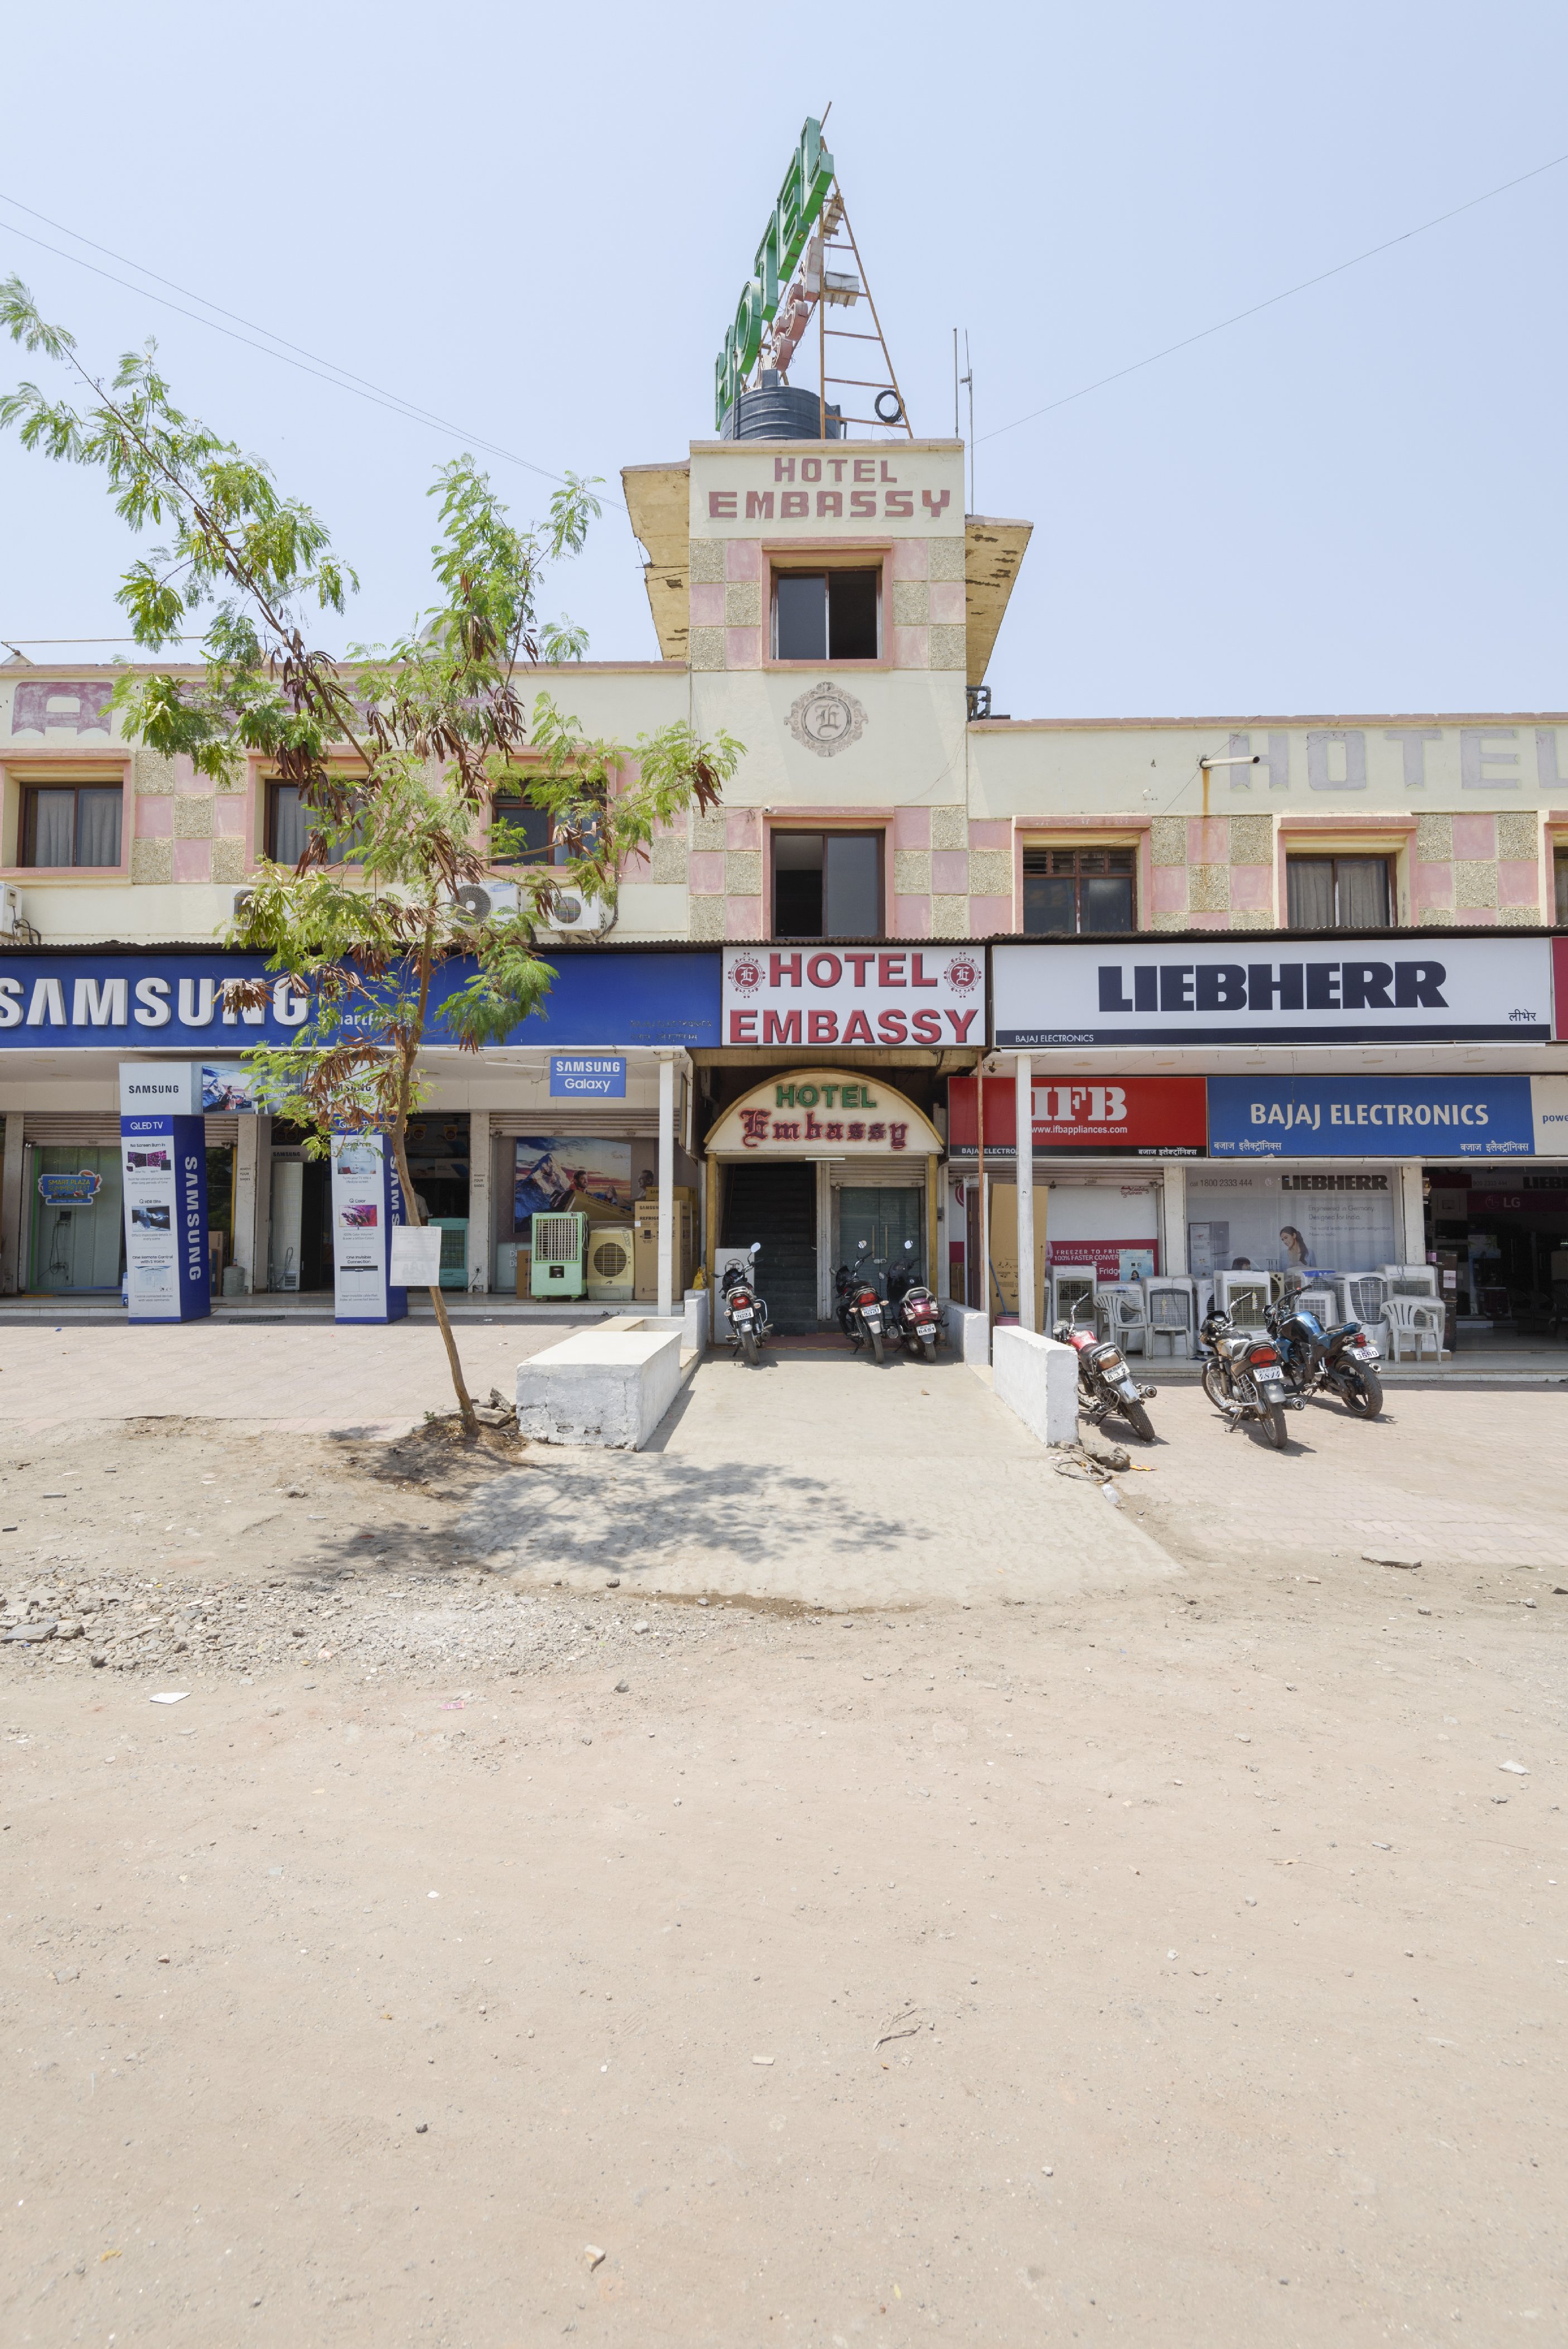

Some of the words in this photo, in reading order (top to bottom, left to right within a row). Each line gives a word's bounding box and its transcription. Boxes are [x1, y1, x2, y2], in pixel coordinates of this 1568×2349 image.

[715, 117, 834, 432] HOTEL
[774, 457, 898, 483] HOTEL
[708, 489, 951, 519] EMBASSY
[1229, 727, 1568, 790] HOTEL
[769, 952, 938, 988] HOTEL
[1098, 961, 1449, 1012] LIEBHERR
[730, 1009, 979, 1044] EMBASSY
[1016, 1035, 1038, 1043] BAJAJ
[556, 1061, 620, 1072] SAMSUNG
[565, 1078, 611, 1093] Galaxy
[776, 1085, 877, 1108] HOTEL
[1031, 1087, 1127, 1121] IFB
[1250, 1104, 1320, 1130] BAJAJ
[1331, 1104, 1489, 1125] ELECTRONICS
[739, 1108, 909, 1151] Embassy
[1031, 1125, 1127, 1136] www.ifbappliances.com
[1282, 1175, 1388, 1190] LIEBHERR
[1503, 1197, 1520, 1208] LG
[185, 1156, 201, 1281] SAMSUNG
